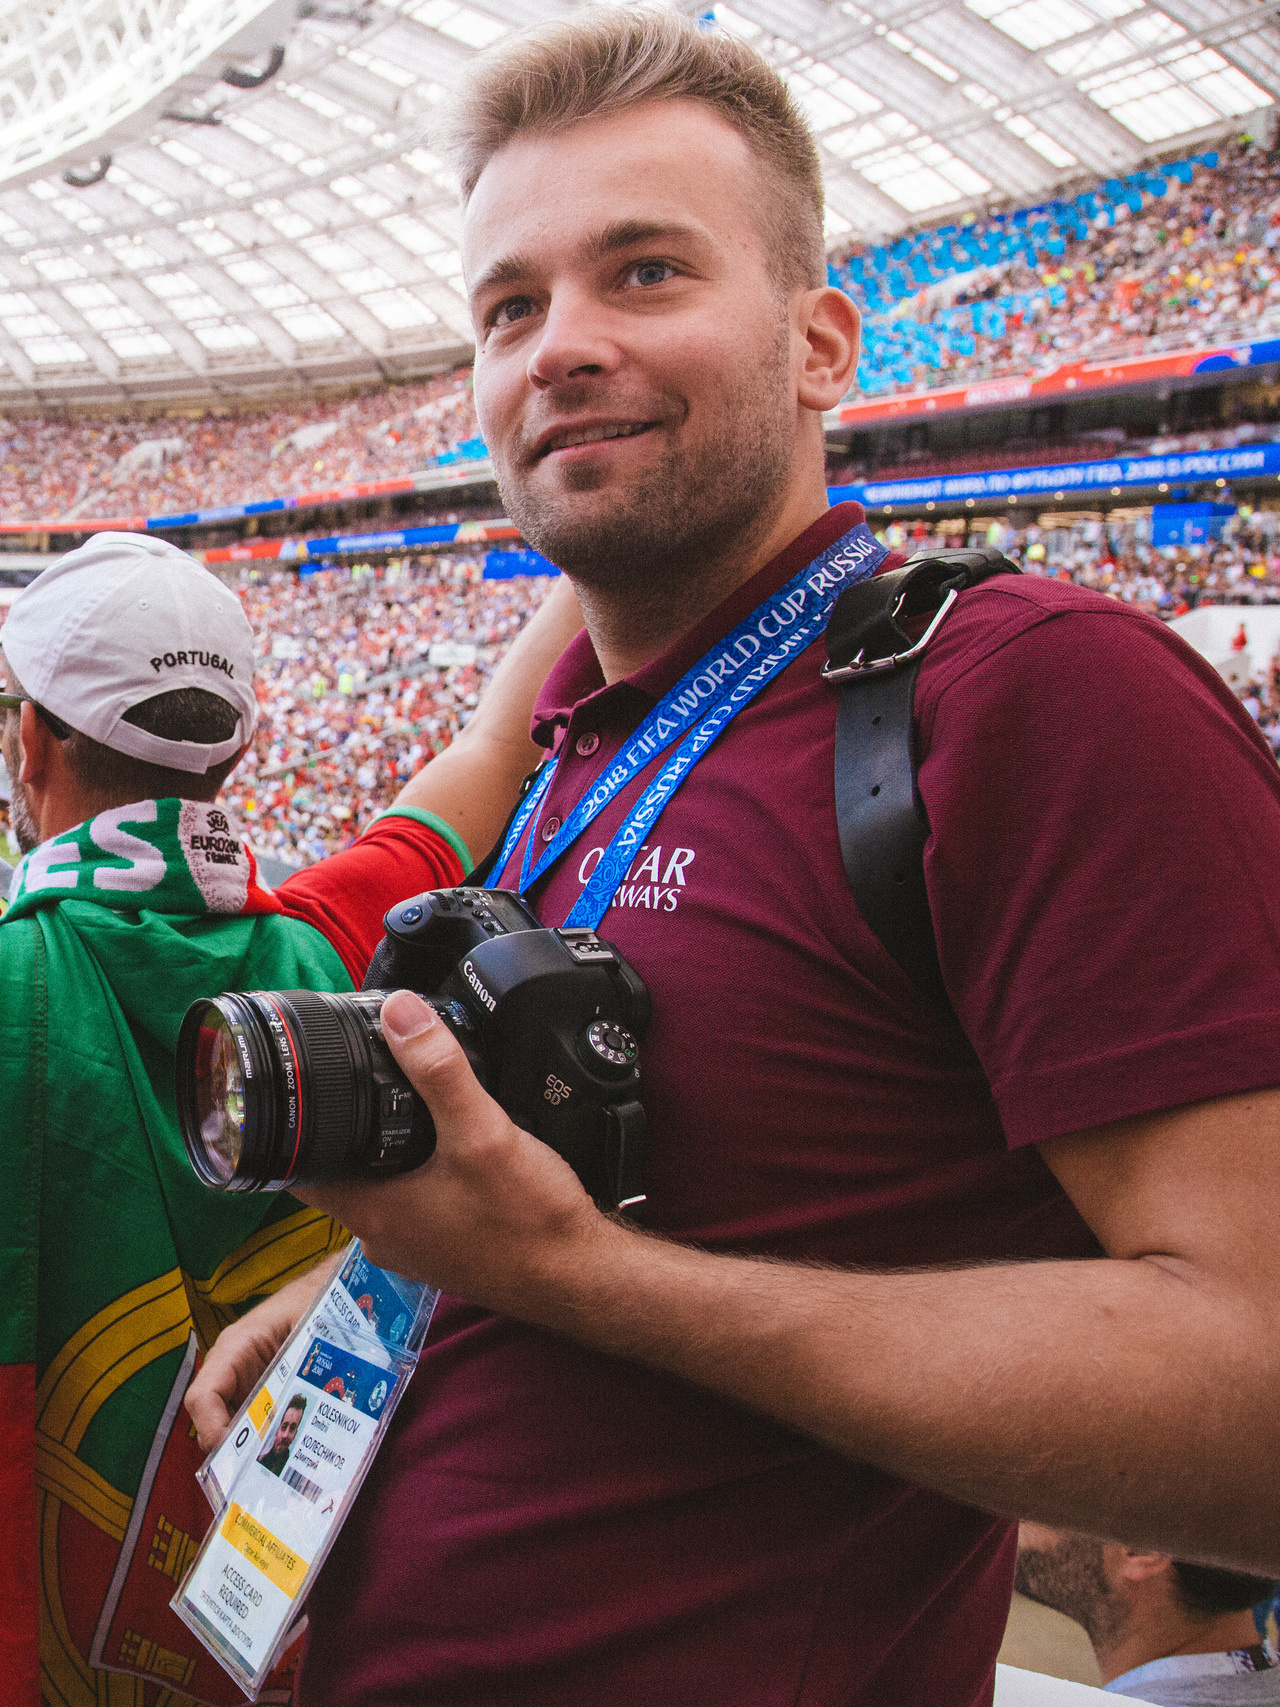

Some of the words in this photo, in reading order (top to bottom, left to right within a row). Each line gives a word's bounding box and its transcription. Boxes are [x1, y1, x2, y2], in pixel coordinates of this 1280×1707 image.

[150, 650, 235, 679] PORTUGAL
[582, 765, 629, 820] 2018
[626, 717, 679, 767] FIFA
[670, 634, 761, 717] WORLD
[758, 588, 806, 637] CUP
[807, 537, 877, 596] RUSSIA
[692, 705, 733, 753] CUP
[617, 756, 691, 847] RUSSIA
[501, 813, 530, 862] 2018
[578, 846, 696, 886] QAR
[612, 885, 681, 912] WAYS
[464, 960, 497, 1012] Canon
[280, 1037, 290, 1056] LENS
[286, 1061, 296, 1090] ZOOM
[546, 1074, 572, 1098] EOS
[544, 1089, 561, 1105] 6D
[317, 1401, 361, 1434] KOLESNIKOV
[293, 1448, 320, 1471] Дмитрий
[301, 1434, 346, 1470] КОЛЕСНИКОВ
[265, 1540, 296, 1571] AFFILIATES
[218, 1583, 249, 1619] REQUIRED
[222, 1563, 246, 1591] ACCESS
[243, 1584, 263, 1607] CARD
